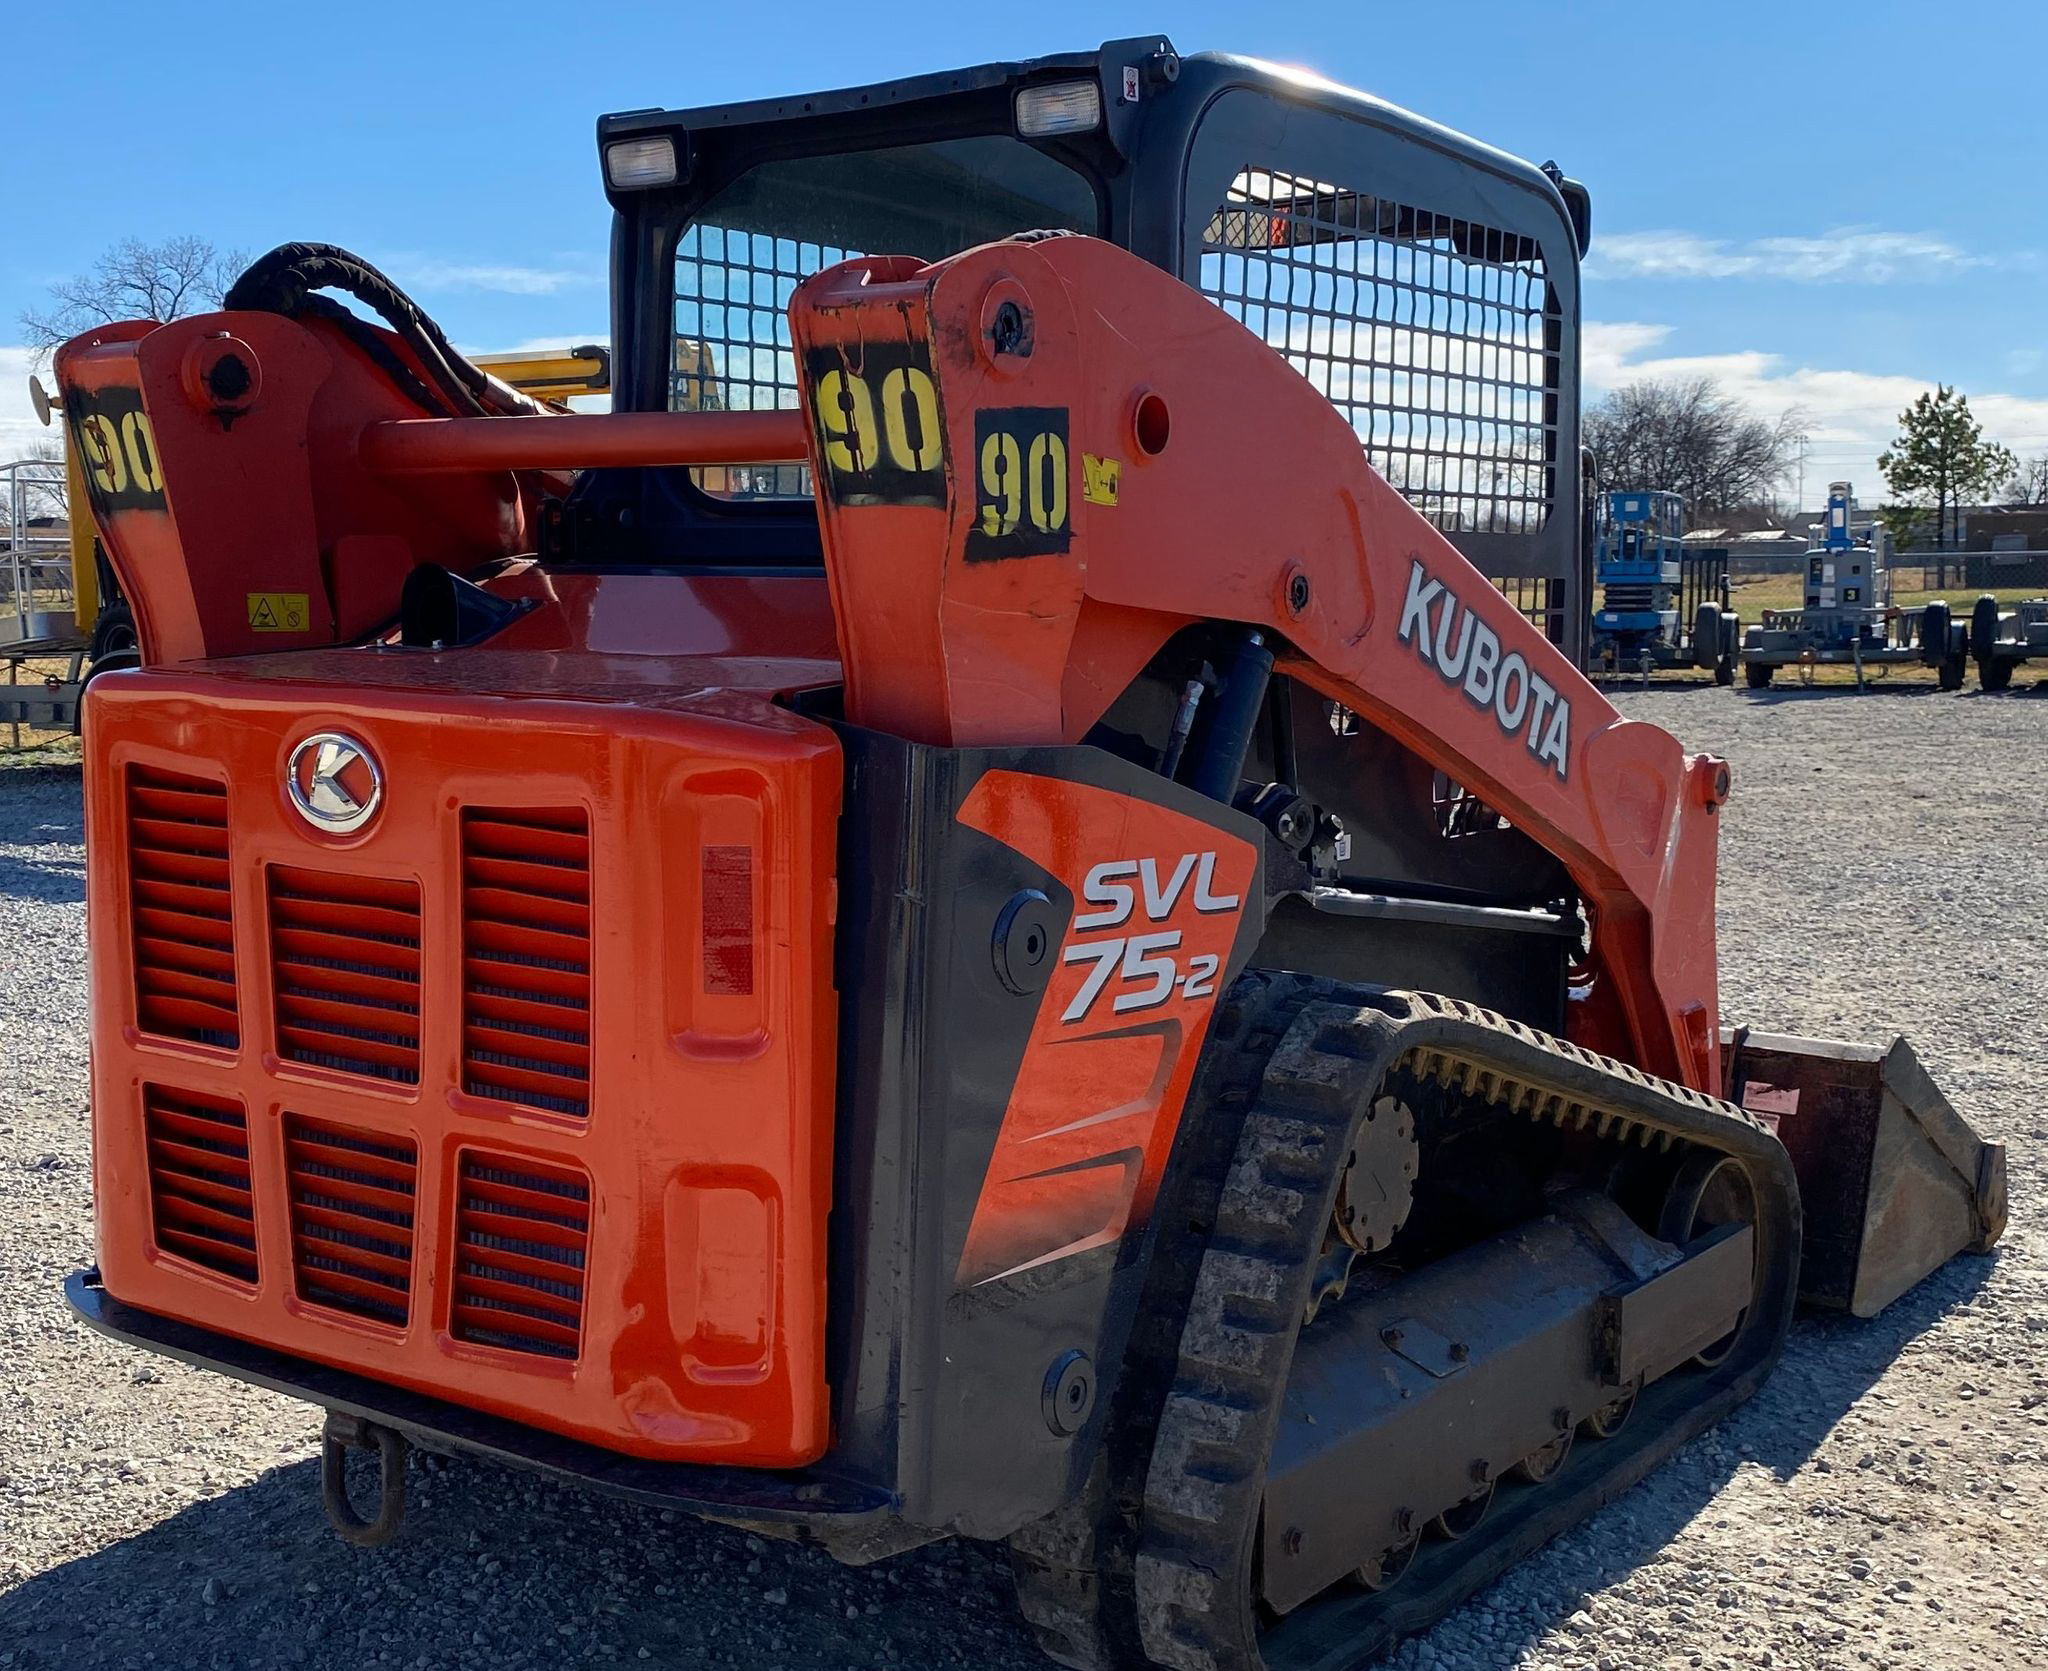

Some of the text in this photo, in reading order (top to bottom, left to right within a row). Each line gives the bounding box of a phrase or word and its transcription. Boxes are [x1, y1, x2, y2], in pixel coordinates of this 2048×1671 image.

[84, 411, 163, 492] 90
[819, 367, 944, 473] 90
[981, 432, 1066, 537] 90
[1399, 560, 1570, 777] KUBOTA
[1074, 851, 1239, 930] SVL
[1060, 929, 1219, 1022] 75-2
